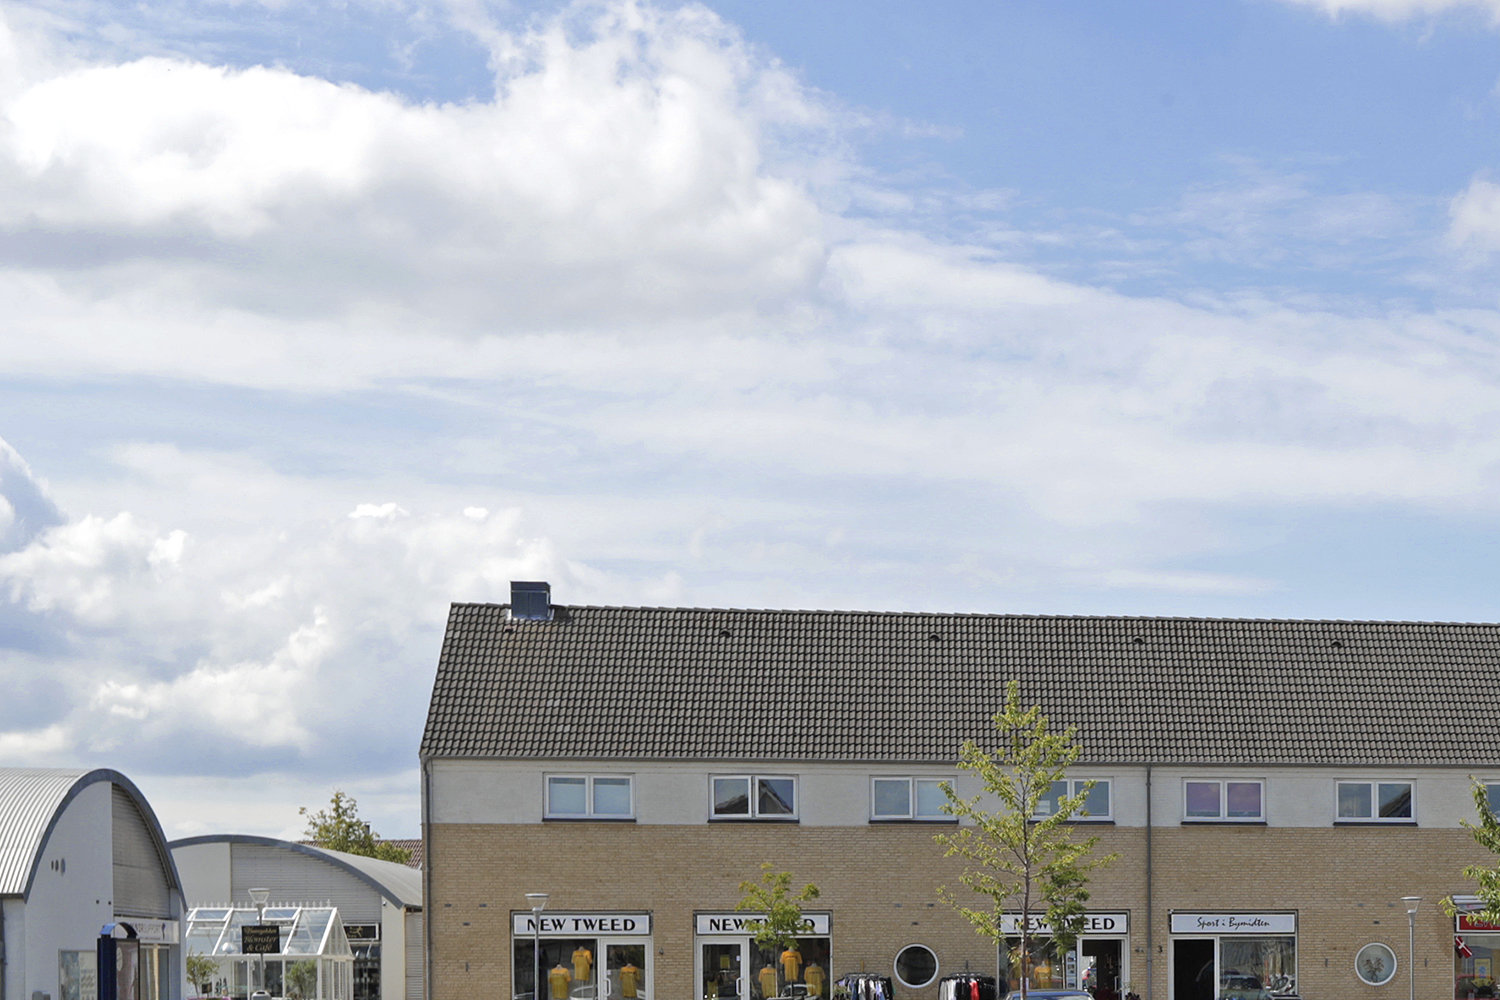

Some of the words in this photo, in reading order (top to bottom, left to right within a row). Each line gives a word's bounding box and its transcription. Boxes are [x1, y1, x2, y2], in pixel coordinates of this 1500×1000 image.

[527, 918, 566, 931] NEW
[572, 918, 636, 931] TWEED
[709, 918, 746, 931] NEW
[1197, 917, 1219, 930] Sport
